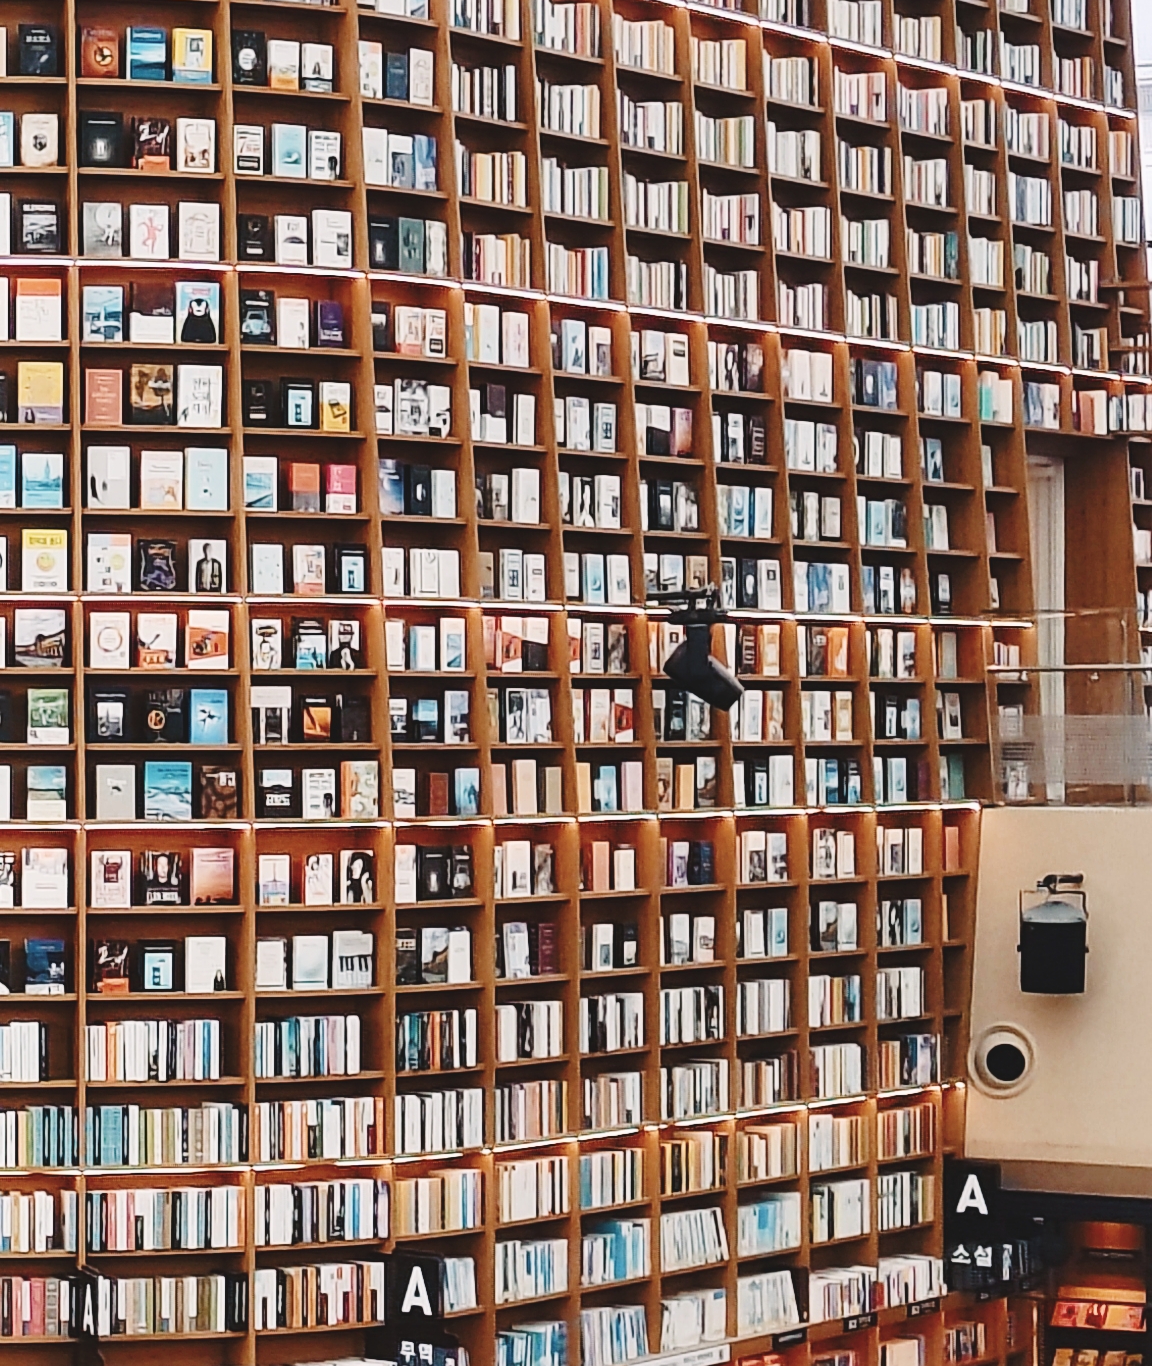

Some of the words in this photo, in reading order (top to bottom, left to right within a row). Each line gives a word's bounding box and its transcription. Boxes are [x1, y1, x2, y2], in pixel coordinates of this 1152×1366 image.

[956, 1173, 989, 1215] A
[950, 1243, 993, 1268] 소설
[83, 1283, 95, 1336] A
[401, 1265, 433, 1316] A
